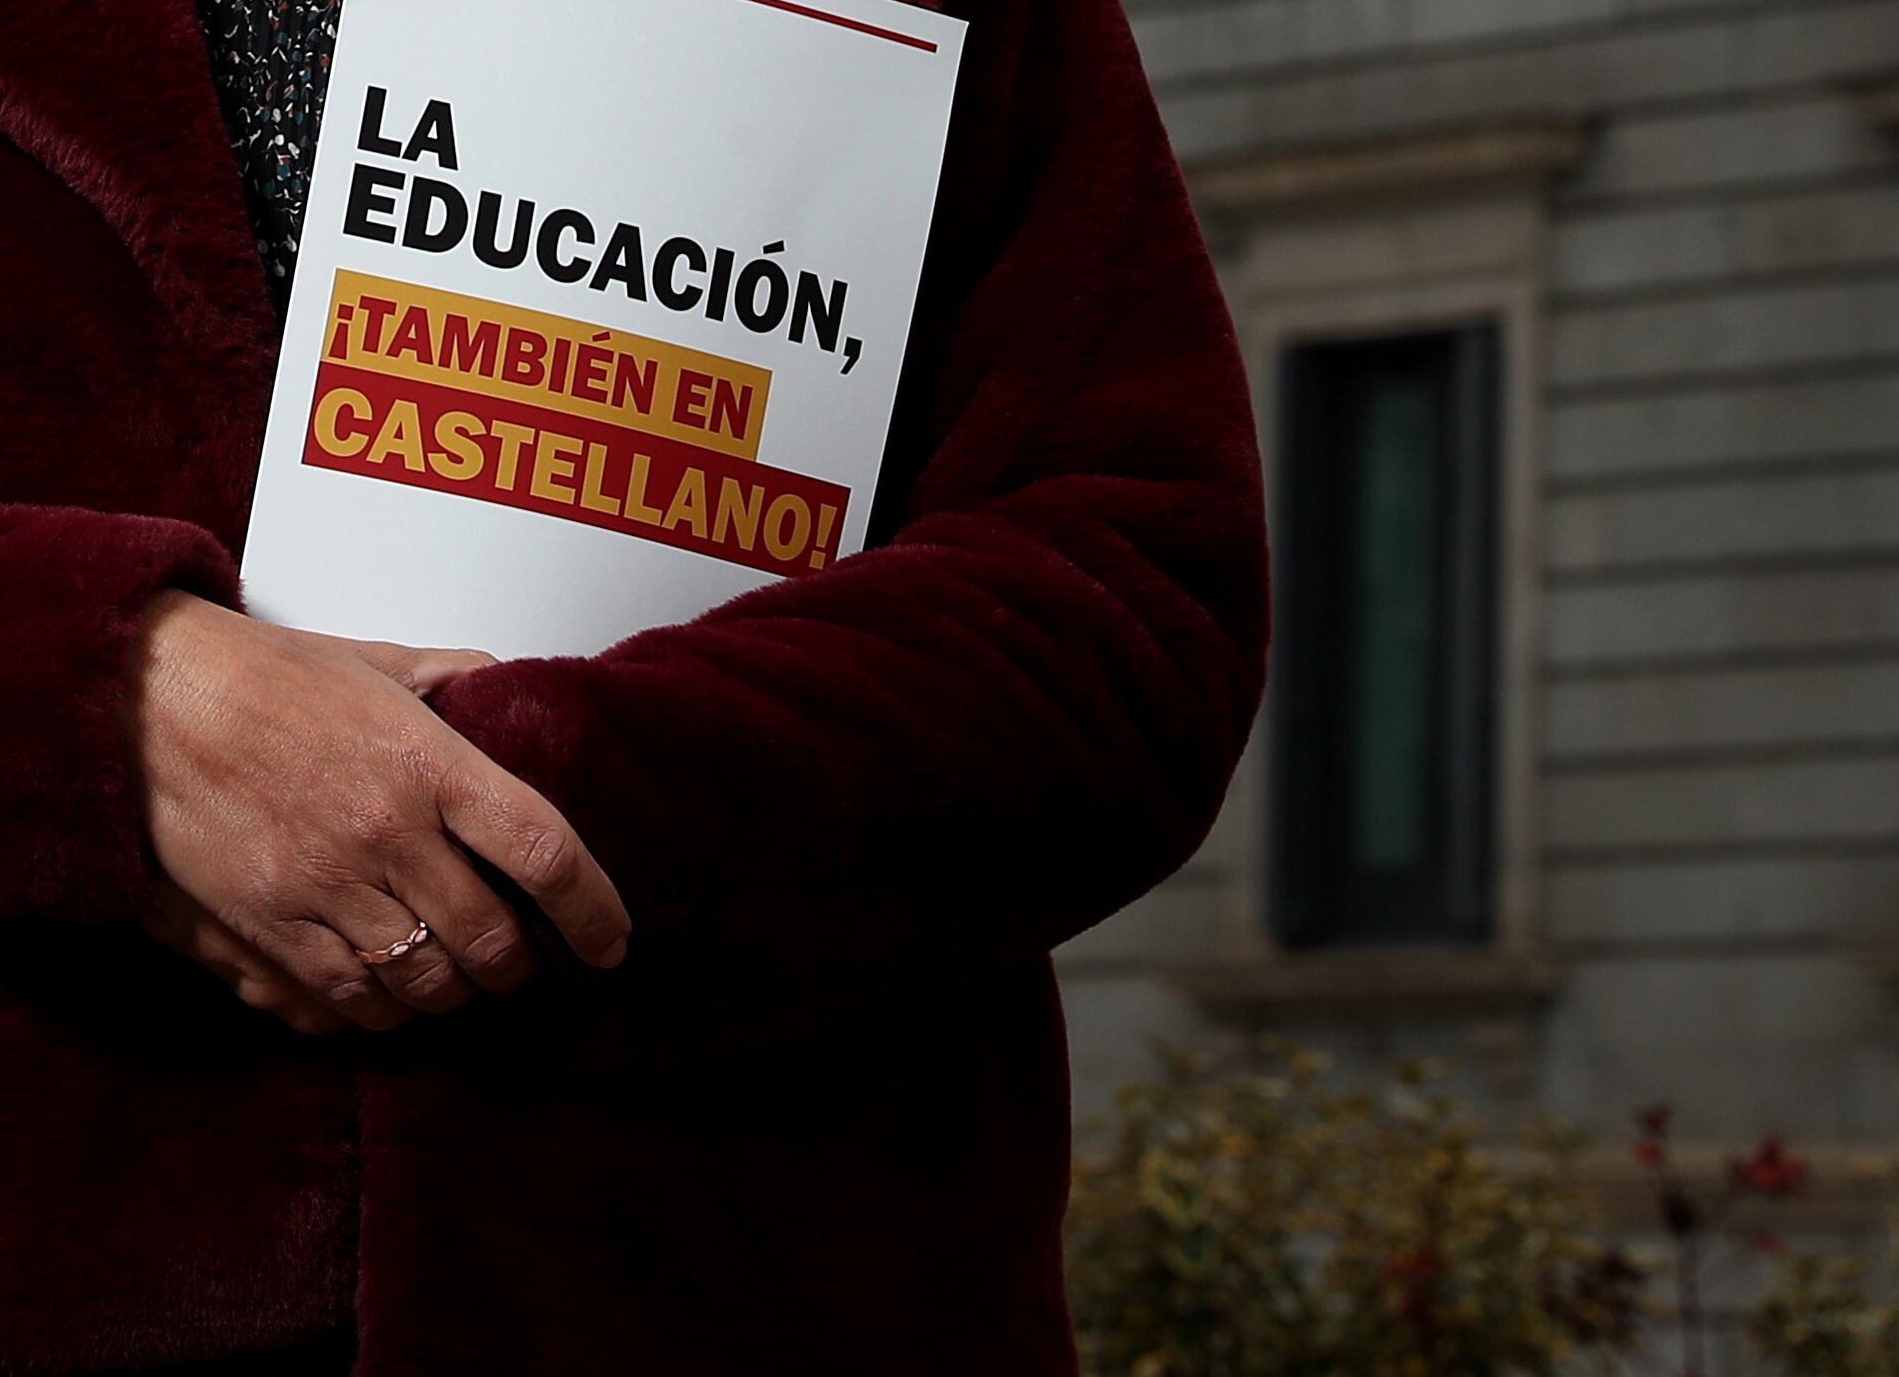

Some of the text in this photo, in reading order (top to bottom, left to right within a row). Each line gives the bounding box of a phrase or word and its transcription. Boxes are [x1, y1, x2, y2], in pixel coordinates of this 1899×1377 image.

[357, 85, 459, 171] LA
[342, 162, 864, 376] EDUCACIÓN,
[327, 294, 755, 441] ¡TAMBIÉN EN
[313, 387, 838, 570] CASTELLANO!
